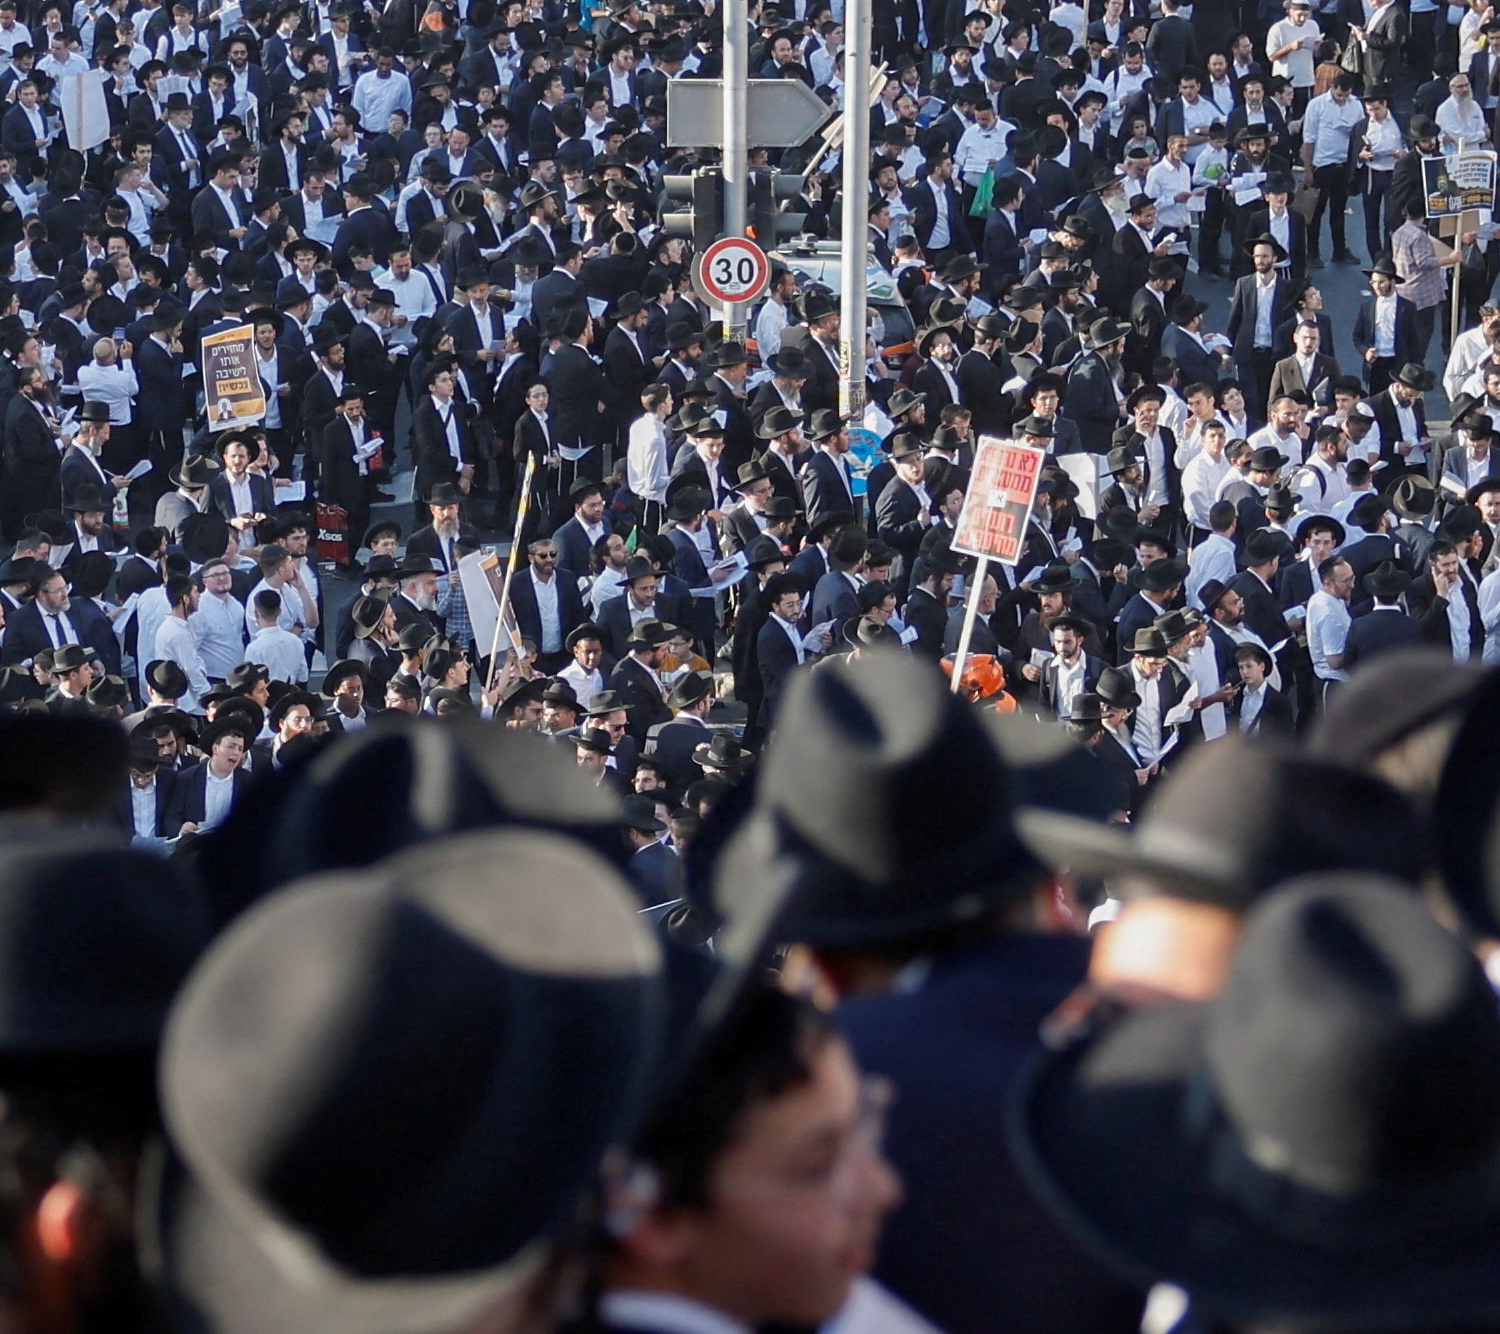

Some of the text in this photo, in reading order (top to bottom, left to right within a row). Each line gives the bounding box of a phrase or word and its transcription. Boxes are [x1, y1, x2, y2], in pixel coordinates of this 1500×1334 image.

[714, 257, 754, 286] 30
[211, 342, 245, 357] מחזירים
[219, 355, 241, 366] אותו
[216, 366, 247, 379] לישיבה
